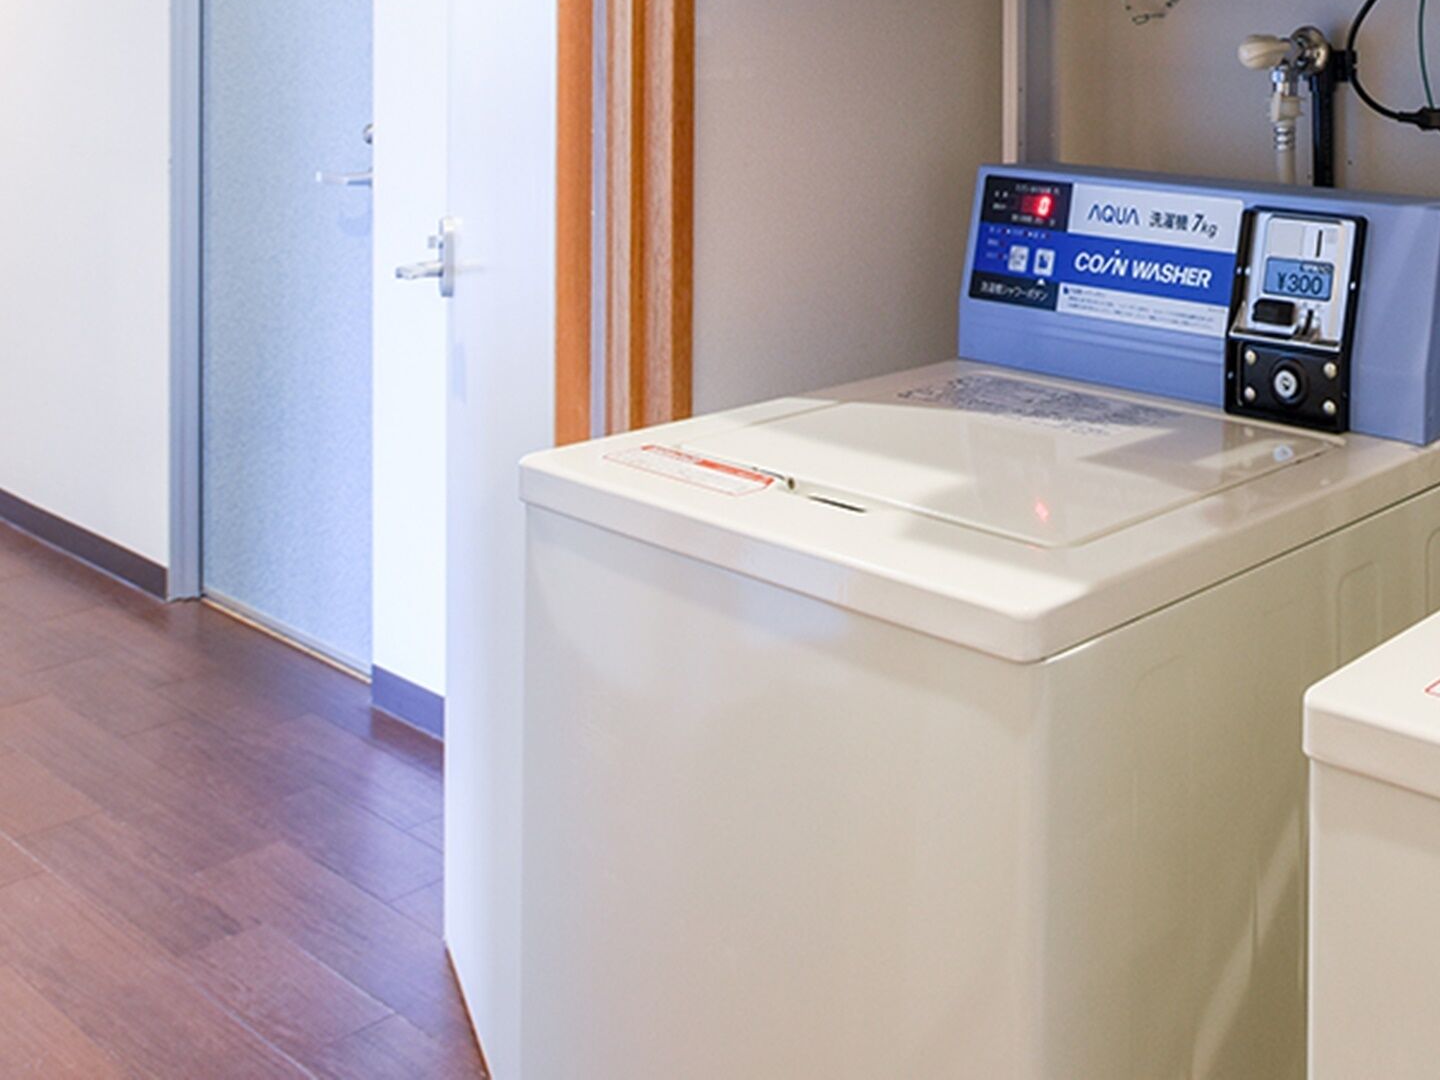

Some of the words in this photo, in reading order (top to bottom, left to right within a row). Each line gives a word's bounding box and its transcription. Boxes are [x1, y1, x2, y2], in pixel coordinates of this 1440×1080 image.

[1088, 203, 1140, 227] AQUA
[1150, 211, 1189, 232] 洗濯機
[1191, 214, 1218, 239] 7kg
[1132, 261, 1213, 289] WASHER
[1277, 272, 1324, 296] ¥300
